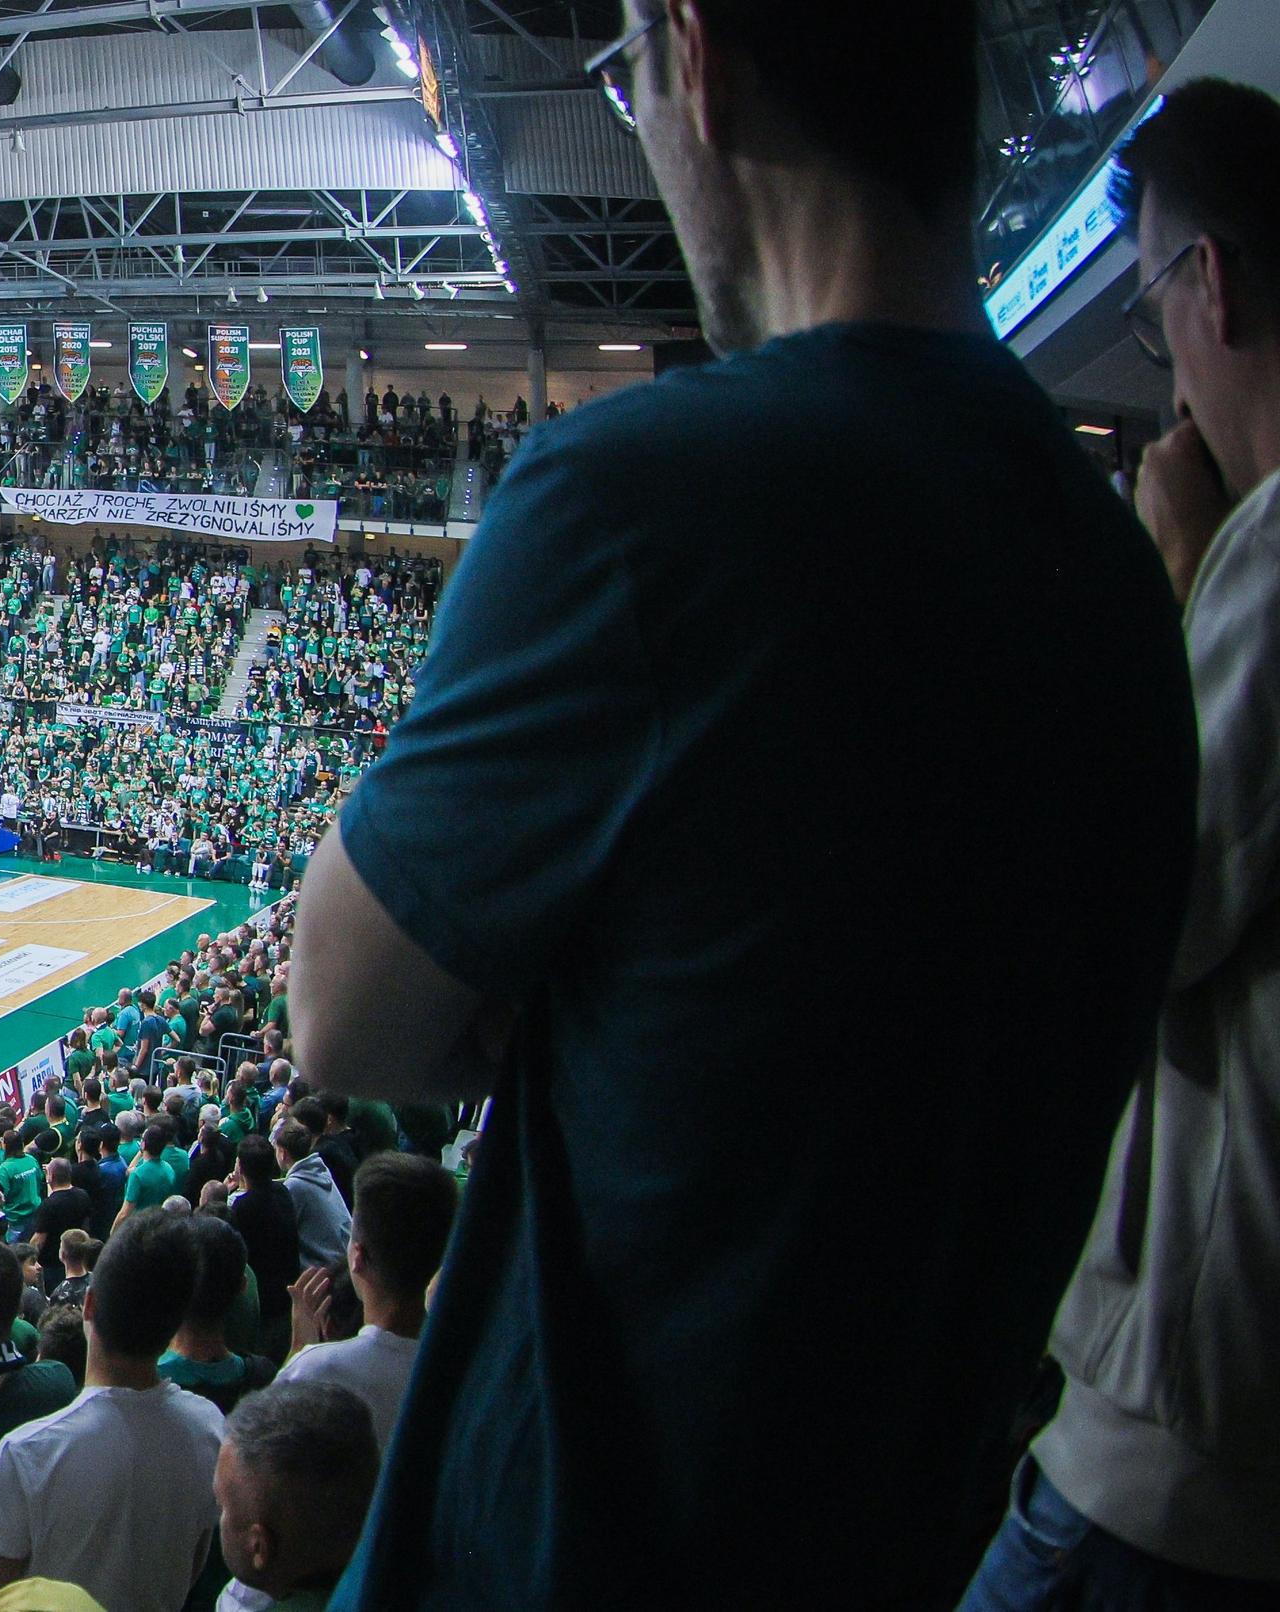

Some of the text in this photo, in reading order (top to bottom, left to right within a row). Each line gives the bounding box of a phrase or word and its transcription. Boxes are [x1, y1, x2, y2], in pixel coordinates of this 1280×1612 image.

[131, 326, 164, 334] PUCHAR
[216, 329, 241, 337] POLISH
[55, 331, 88, 339] POLSKI
[131, 333, 164, 342] POLSKI
[211, 335, 247, 343] SUPERCUP
[285, 331, 313, 339] POLISH
[62, 341, 82, 349] 2020
[292, 337, 308, 345] CUP
[138, 342, 157, 351] 2017
[219, 346, 239, 354] 2021
[291, 348, 310, 356] 2021
[15, 492, 287, 519] CHOCIAŻ TROCHĘ ZWOLNILIŚMY
[34, 506, 315, 537] MARZEŃ NIE ZREZYGNOWALIŚMY
[186, 717, 232, 728] PAMIĘTAMY
